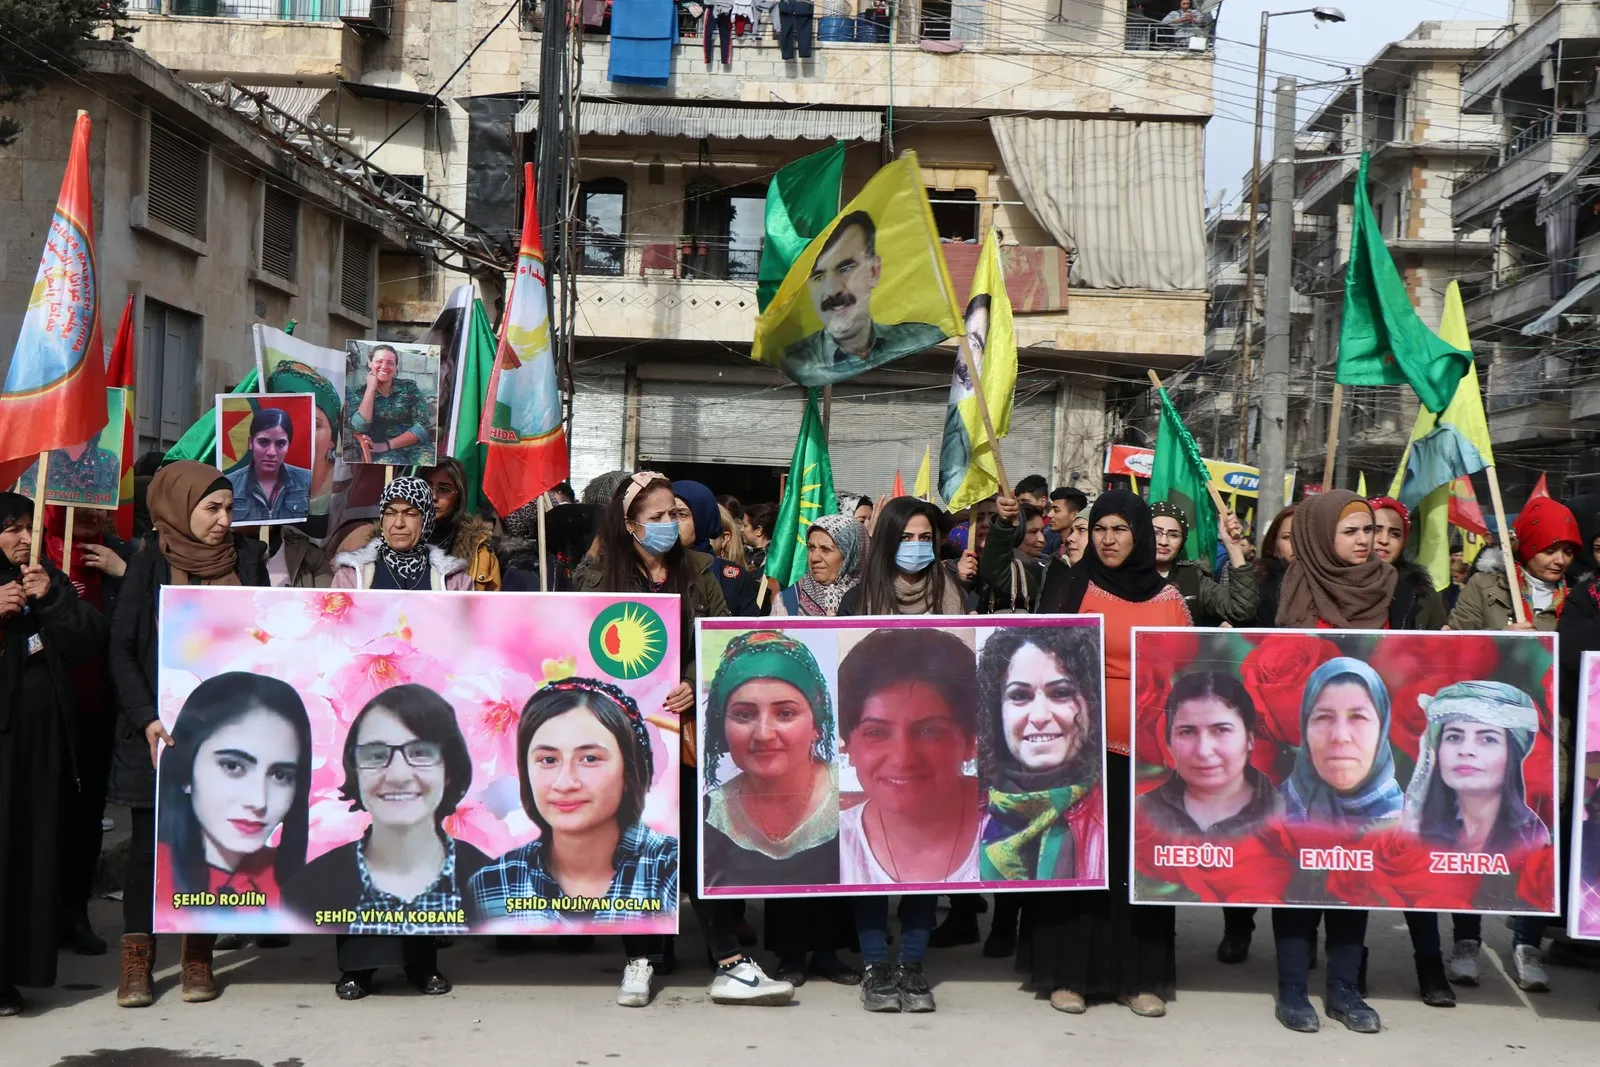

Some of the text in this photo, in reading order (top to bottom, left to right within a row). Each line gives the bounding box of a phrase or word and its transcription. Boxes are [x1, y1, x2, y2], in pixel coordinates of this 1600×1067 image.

[1230, 474, 1260, 489] MTN
[1154, 842, 1234, 868] HEBÛN
[1300, 845, 1374, 872] EMÎNE
[1429, 852, 1510, 875] ZEHRA
[173, 891, 216, 909] ŞEHÎD
[506, 896, 547, 913] ŞEHÎD
[614, 898, 661, 911] OCLAN
[315, 909, 357, 926] ŞEHÎD
[408, 909, 465, 924] KOBANÊ
